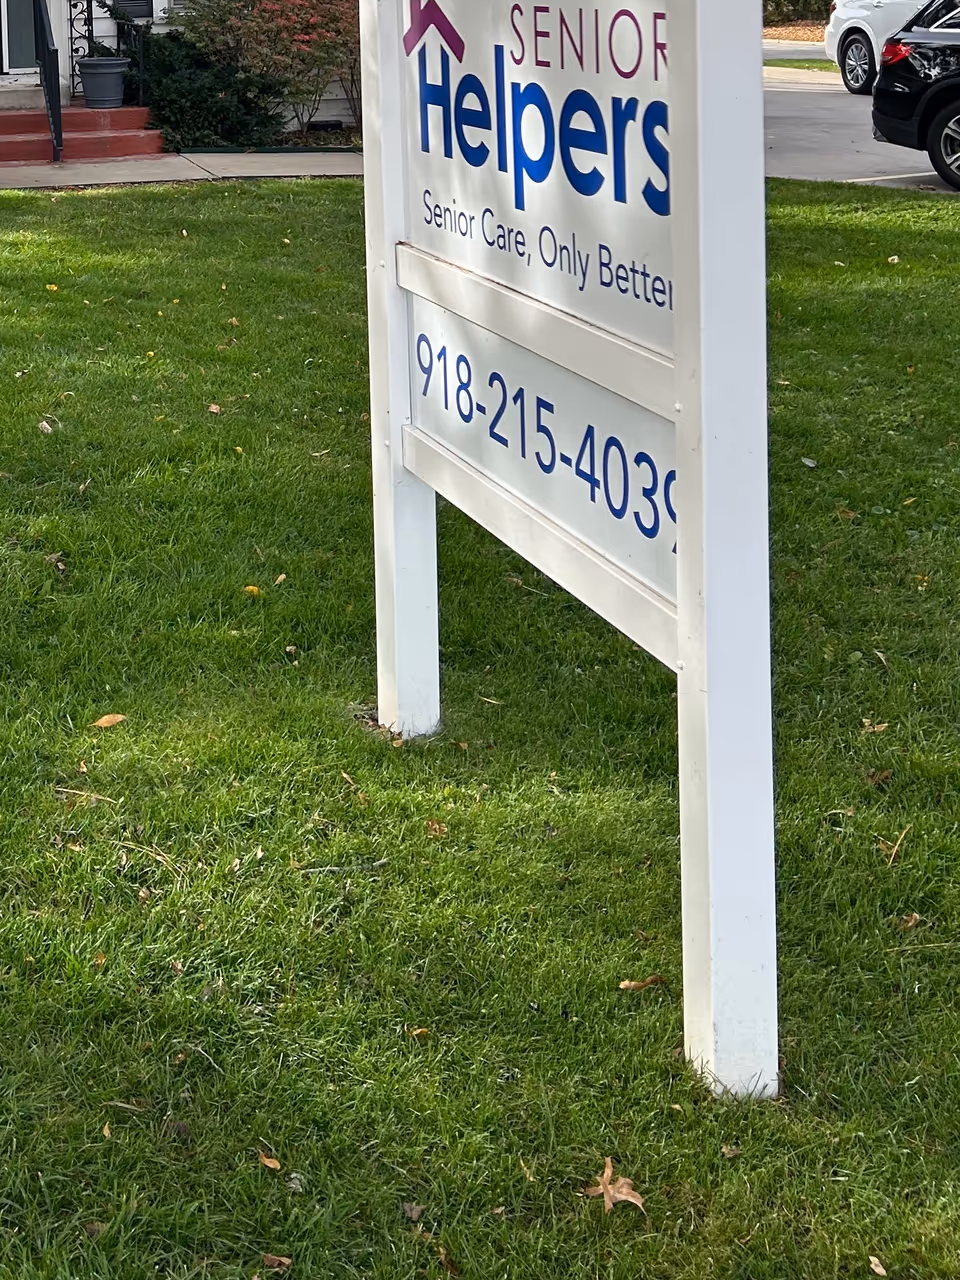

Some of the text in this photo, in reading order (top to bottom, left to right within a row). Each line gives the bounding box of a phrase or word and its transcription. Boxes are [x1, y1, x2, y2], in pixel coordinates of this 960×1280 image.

[418, 42, 671, 216] Helpers
[423, 189, 475, 239] Senior
[481, 208, 531, 266] Care,
[538, 226, 590, 291] Only
